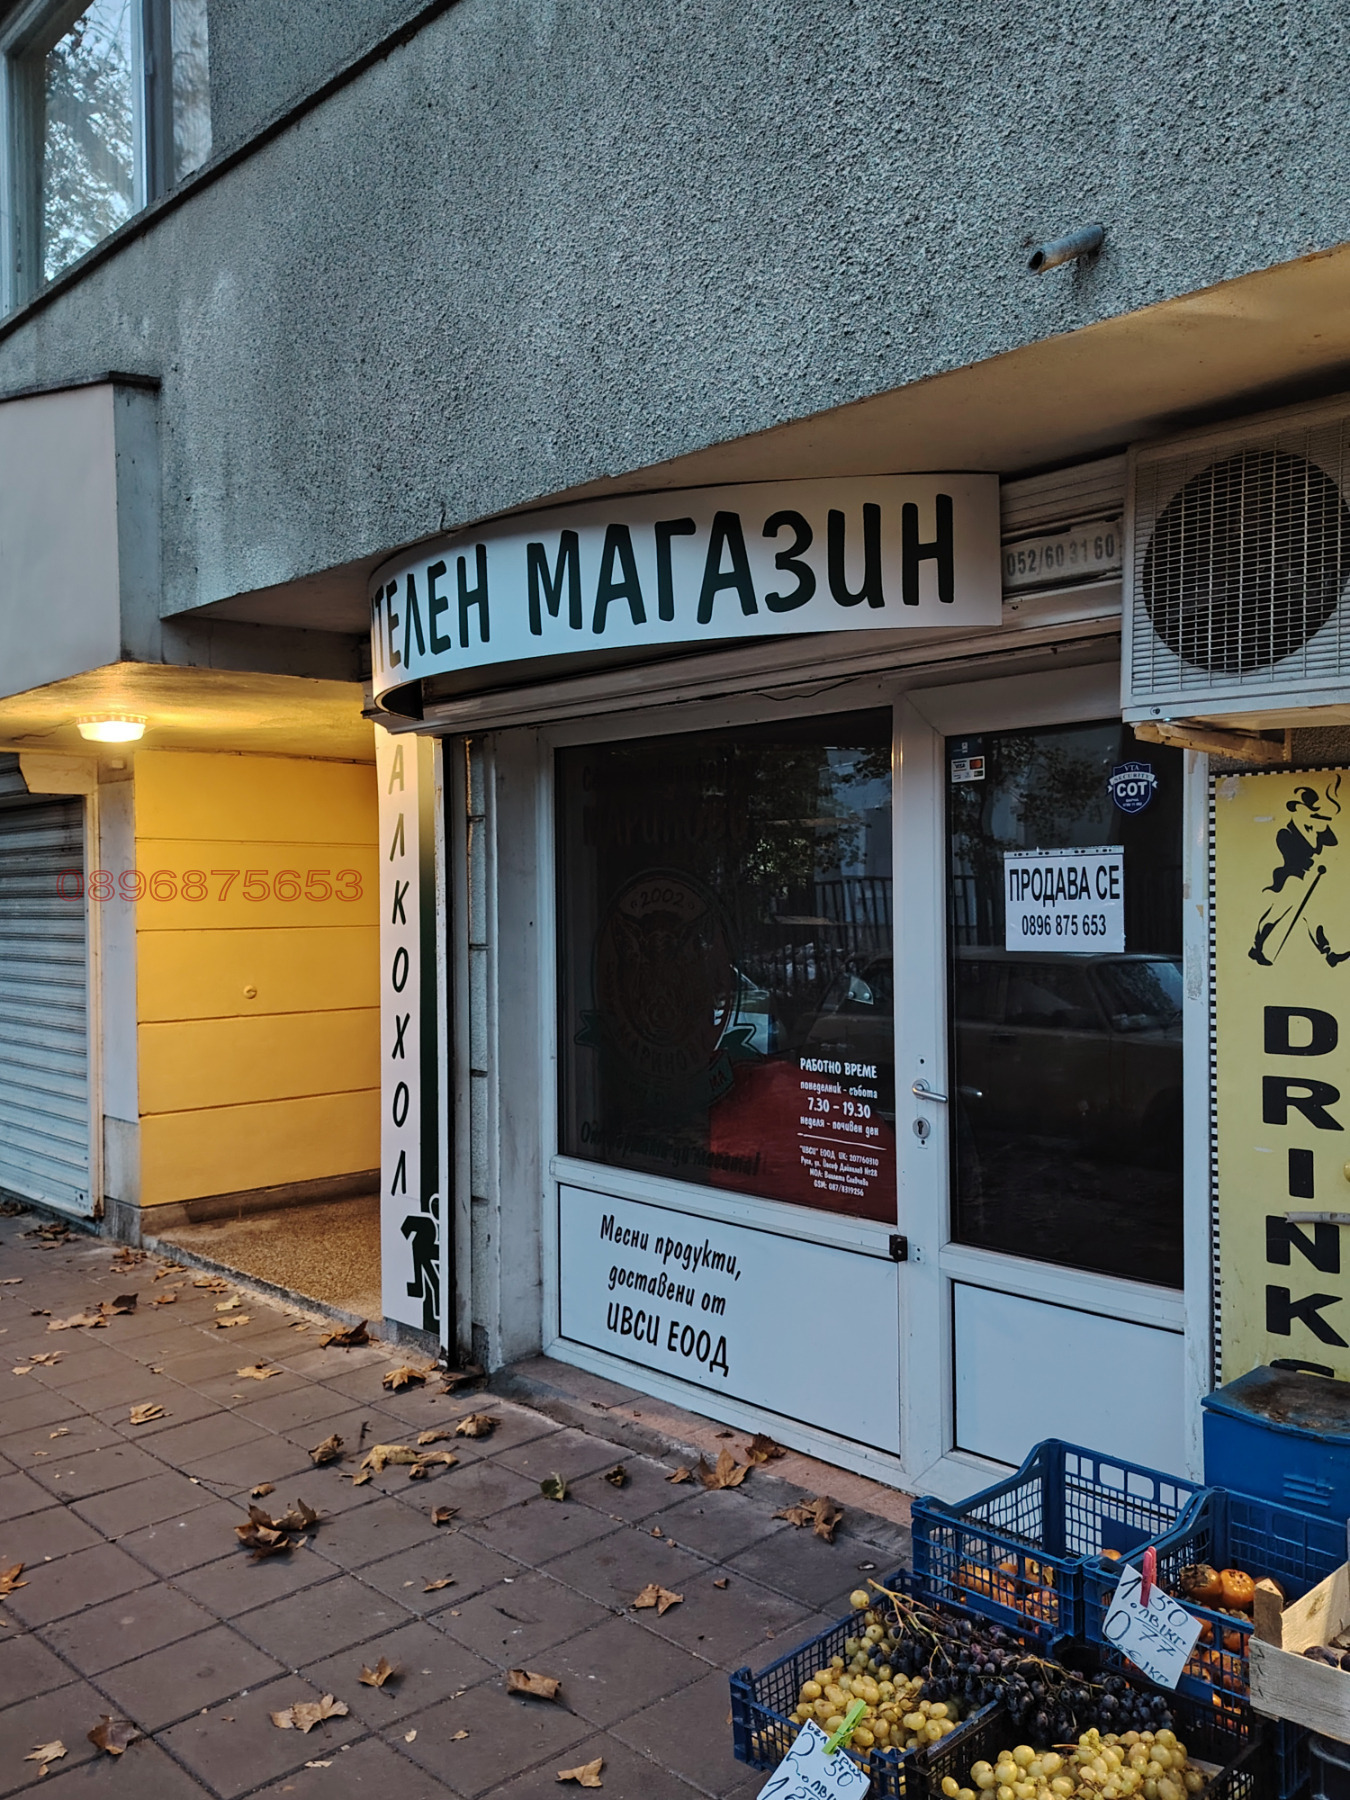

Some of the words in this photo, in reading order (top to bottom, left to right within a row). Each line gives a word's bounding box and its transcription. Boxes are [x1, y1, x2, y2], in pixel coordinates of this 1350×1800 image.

[1006, 543, 1064, 577] 052/60
[1094, 533, 1115, 560] 60
[372, 543, 490, 676] ТЕЛЕН
[526, 493, 955, 636] МАГАЗИН
[640, 887, 685, 908] 2002
[1009, 866, 1091, 907] ПРОДАВА
[1096, 865, 1120, 900] СЕ
[1022, 914, 1051, 936] 0896
[1055, 914, 1079, 936] 875
[1082, 914, 1107, 936] 653
[388, 744, 410, 1197] АЛКОХОЛ
[800, 1057, 842, 1074] РАБОТНО
[844, 1062, 878, 1078] ВРЕМЕ
[800, 1081, 842, 1095] понеделник
[848, 1084, 878, 1099] събота
[807, 1096, 830, 1113] 7.30
[842, 1101, 871, 1119] 19.30
[800, 1116, 825, 1129] неделя
[832, 1120, 863, 1133] почивен
[865, 1126, 879, 1138] ден
[1262, 1005, 1349, 1378] DRINK
[600, 1214, 649, 1251] Месни
[654, 1237, 742, 1281] продукти,
[608, 1265, 695, 1307] доставени
[701, 1292, 726, 1316] от
[607, 1302, 660, 1346] ИВСИ
[667, 1320, 730, 1378] ЕООД
